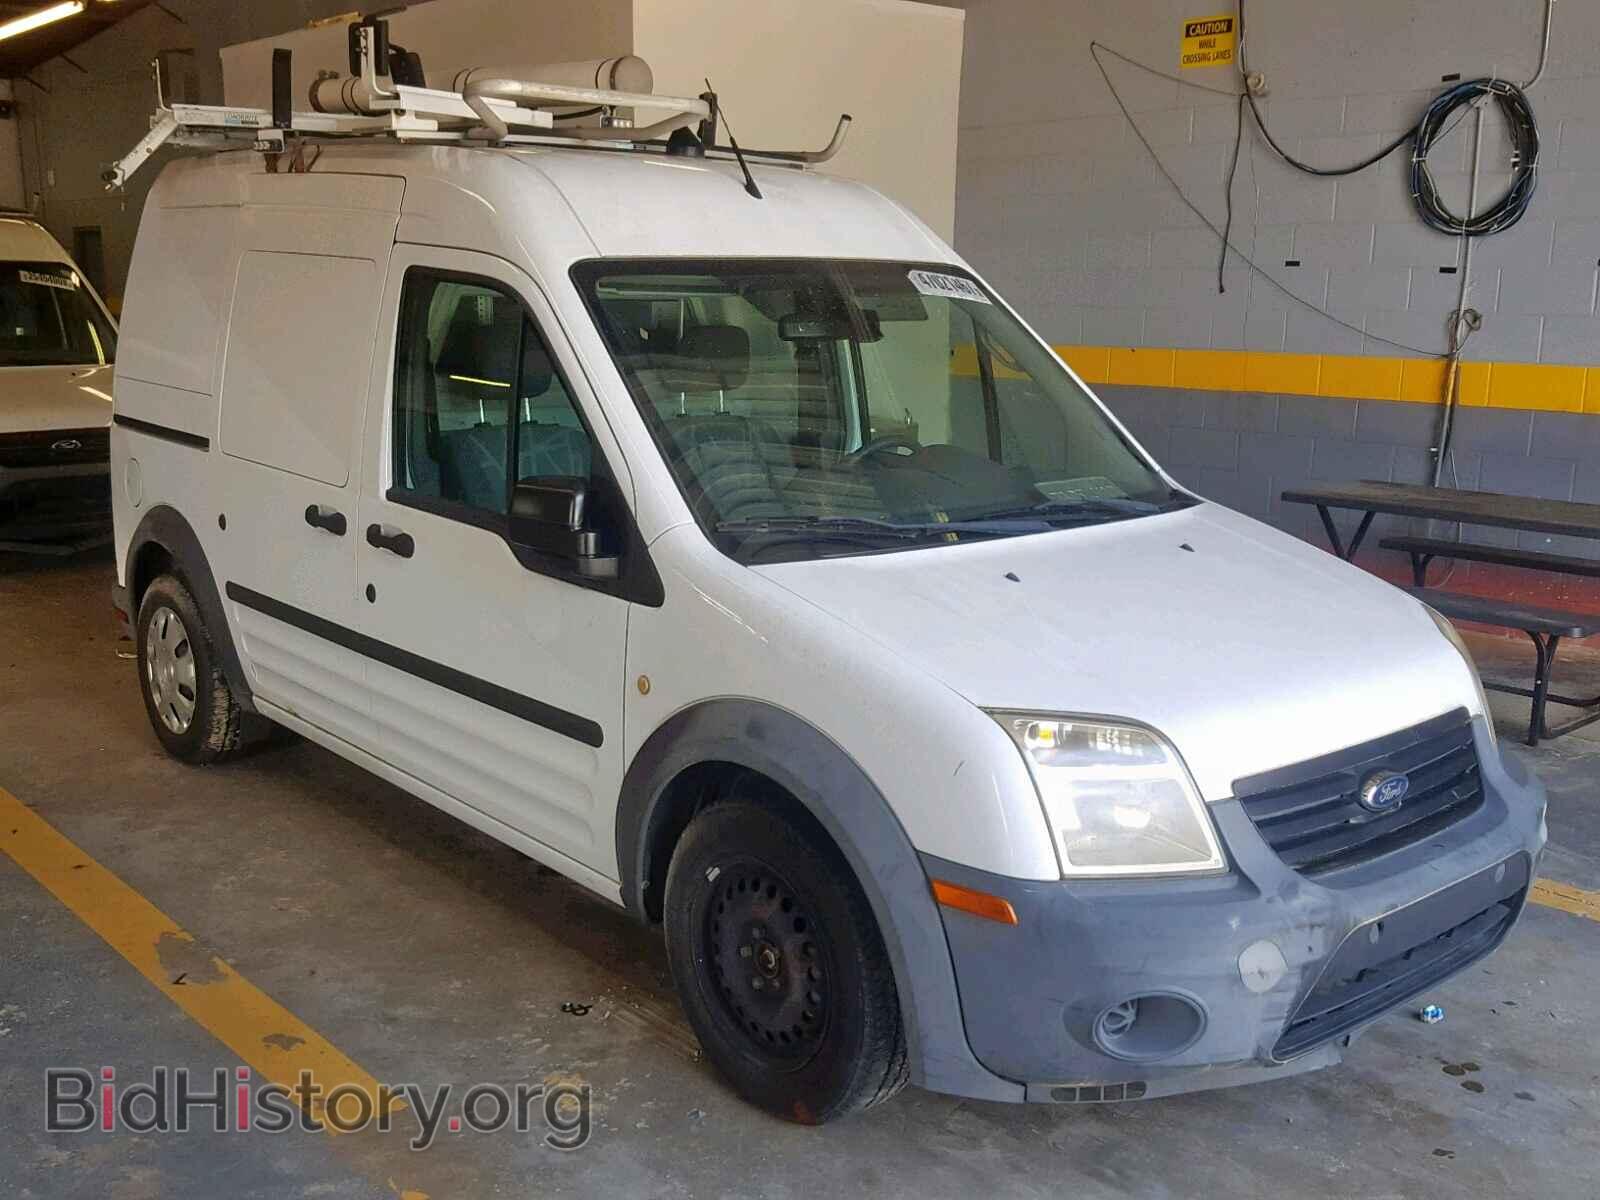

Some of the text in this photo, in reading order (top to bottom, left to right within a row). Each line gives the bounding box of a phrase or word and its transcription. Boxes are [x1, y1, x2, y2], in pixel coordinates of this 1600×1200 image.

[1190, 21, 1228, 35] CAUTION
[1183, 50, 1231, 64] CROSSING LANES
[1379, 780, 1404, 803] Ford
